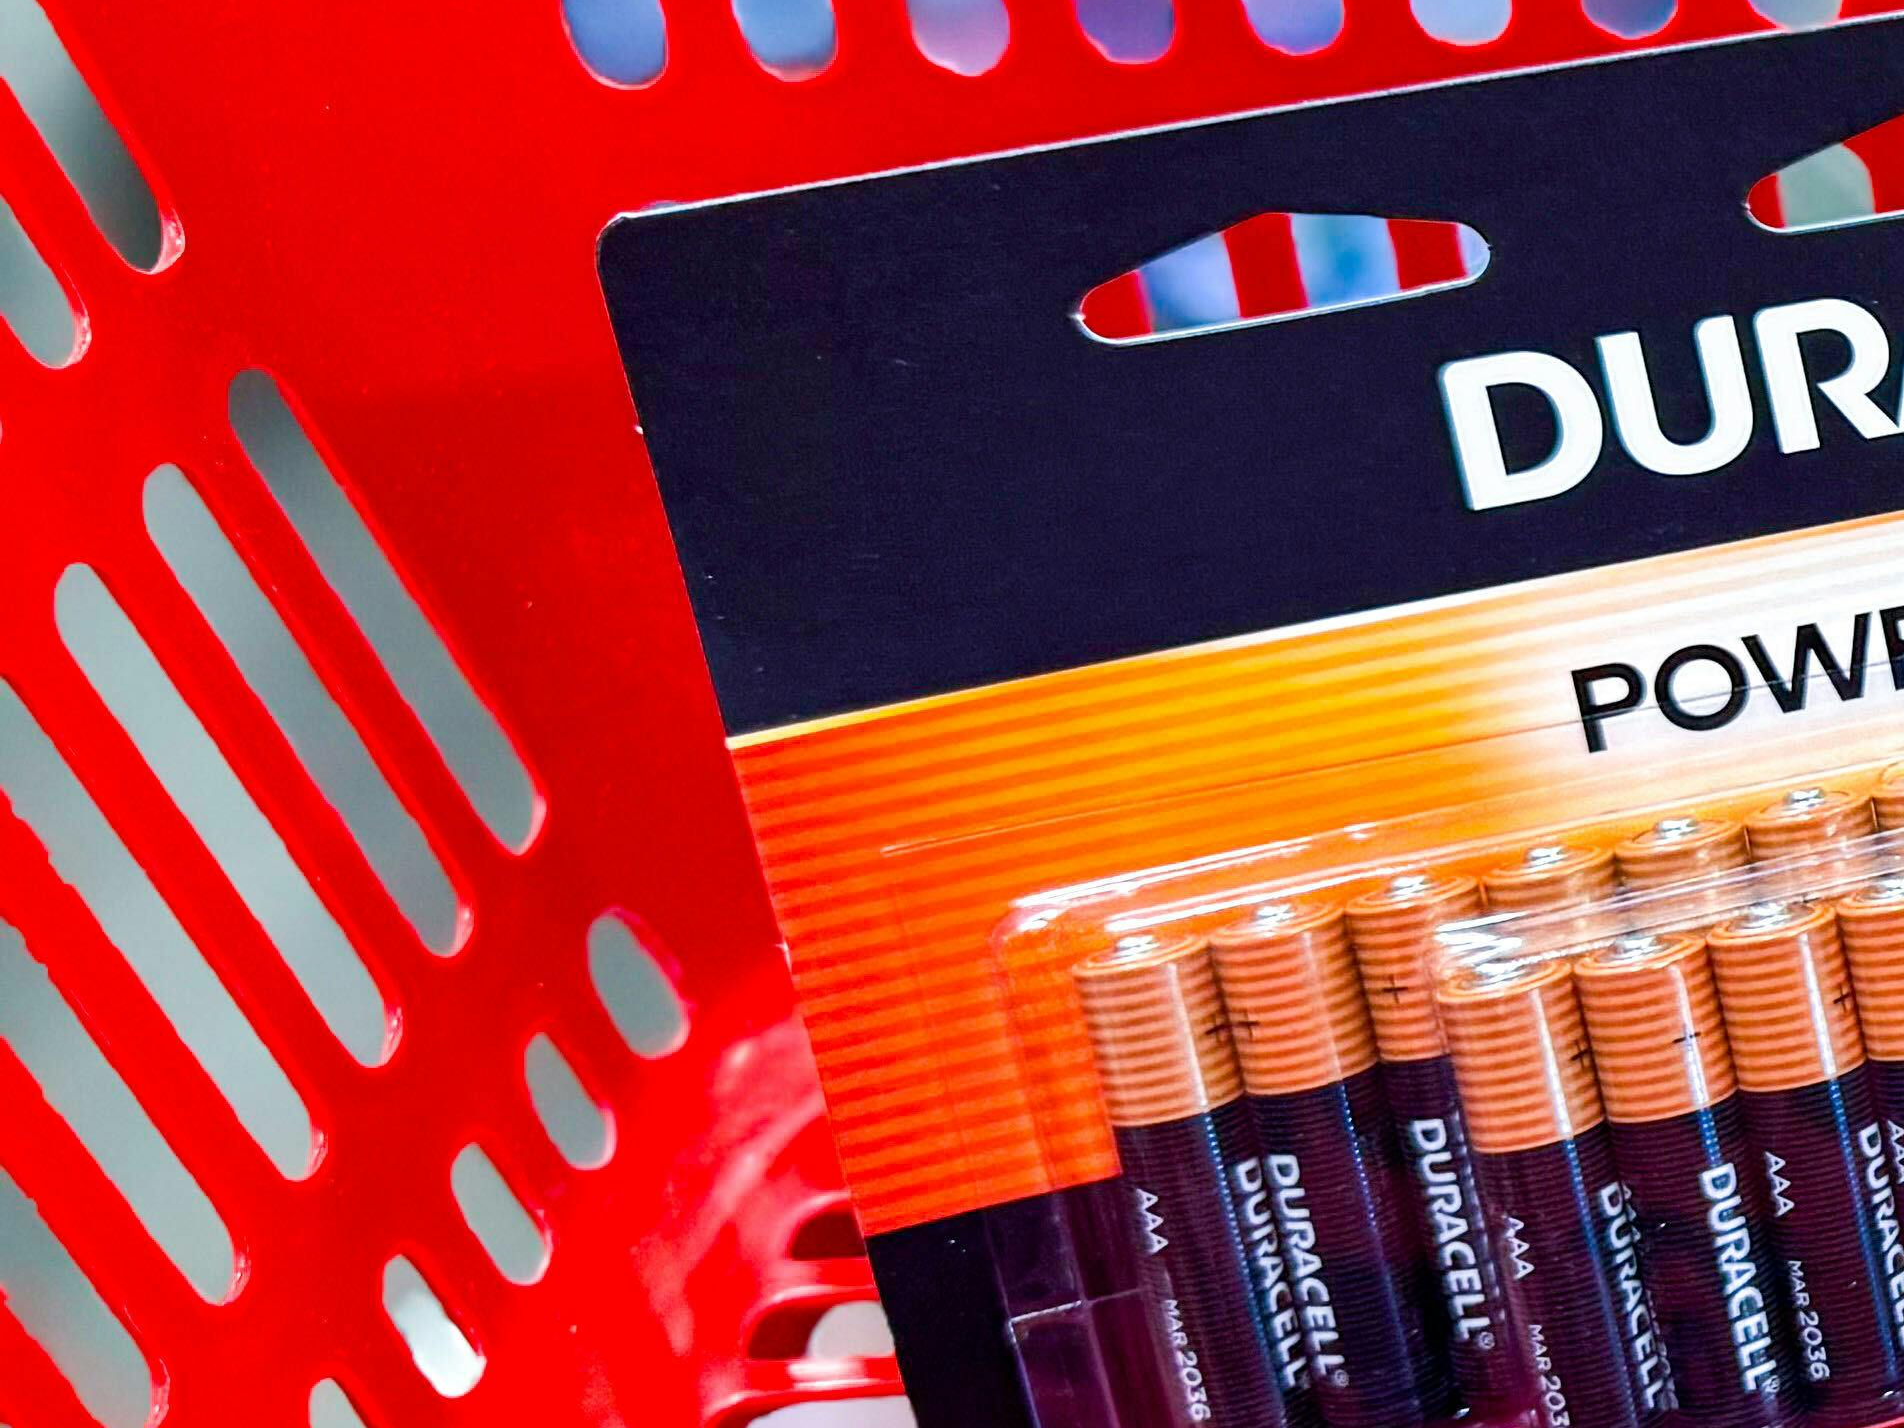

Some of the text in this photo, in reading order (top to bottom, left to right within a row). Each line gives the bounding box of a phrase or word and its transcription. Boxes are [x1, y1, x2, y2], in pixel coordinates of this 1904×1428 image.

[1764, 1151, 1795, 1217] AAA
[1135, 1188, 1168, 1255] AAA
[1504, 1215, 1534, 1280] AAA
